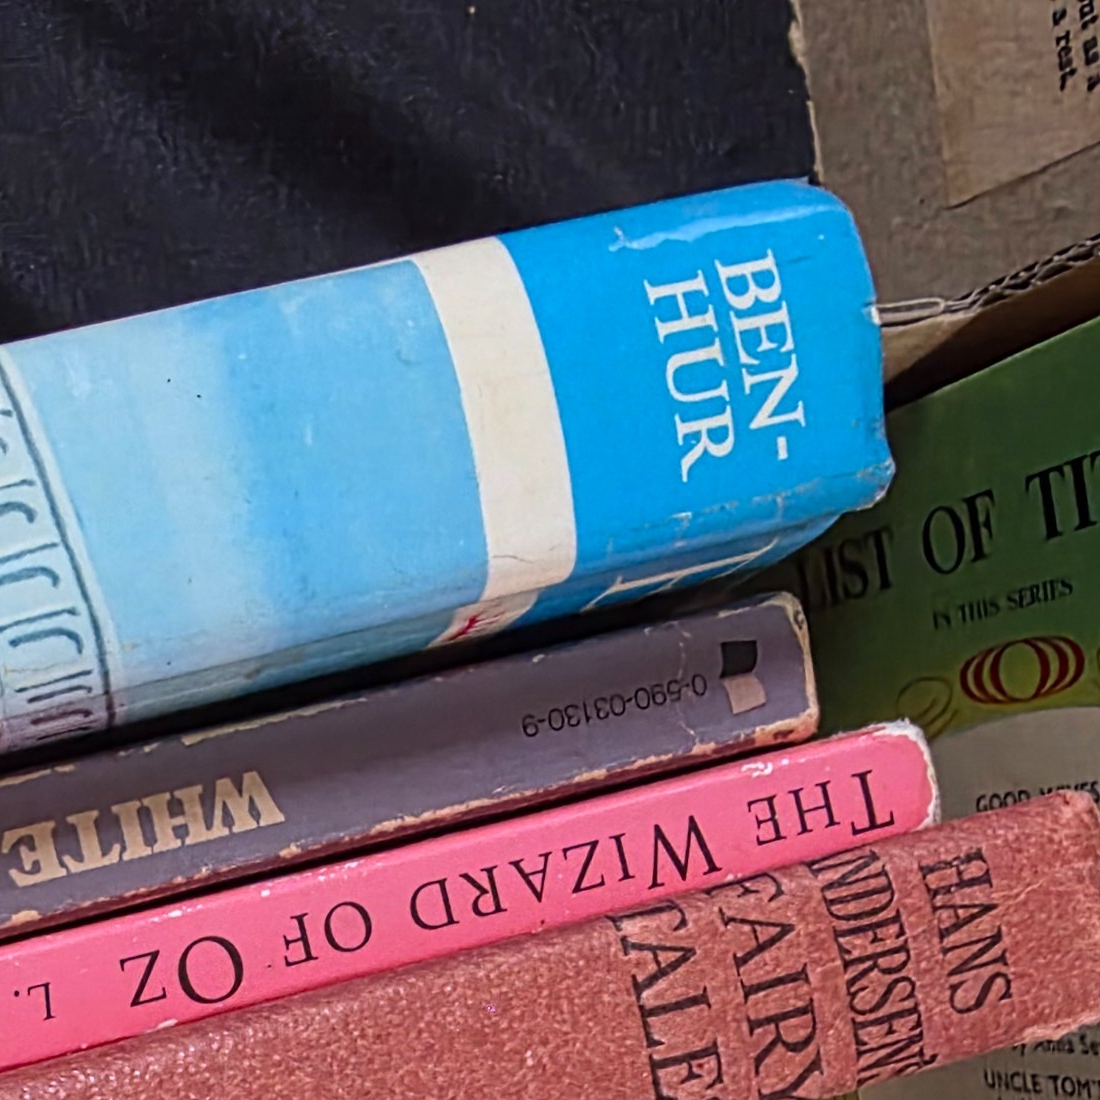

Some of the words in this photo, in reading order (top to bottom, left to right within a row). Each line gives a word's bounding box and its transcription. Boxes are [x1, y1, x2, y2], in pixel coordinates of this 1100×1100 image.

[644, 270, 735, 482] HUR
[715, 248, 806, 460] BEN-
[922, 489, 995, 575] OF
[1025, 451, 1100, 541] TI
[959, 597, 1001, 624] THIS
[1007, 576, 1074, 611] SERIES
[522, 674, 708, 738] 0-590-03130-9
[2, 770, 286, 889] WHITE
[748, 770, 896, 847] THE
[410, 814, 724, 931] WIZARD
[119, 936, 245, 1008] OZ
[282, 900, 373, 968] OF
[805, 848, 938, 1089] NDERSEN'S
[918, 847, 1013, 1015] HANS
[13, 982, 56, 1021] L.
[984, 1068, 1043, 1095] UNCLE
[1048, 1074, 1100, 1100] TOM'
